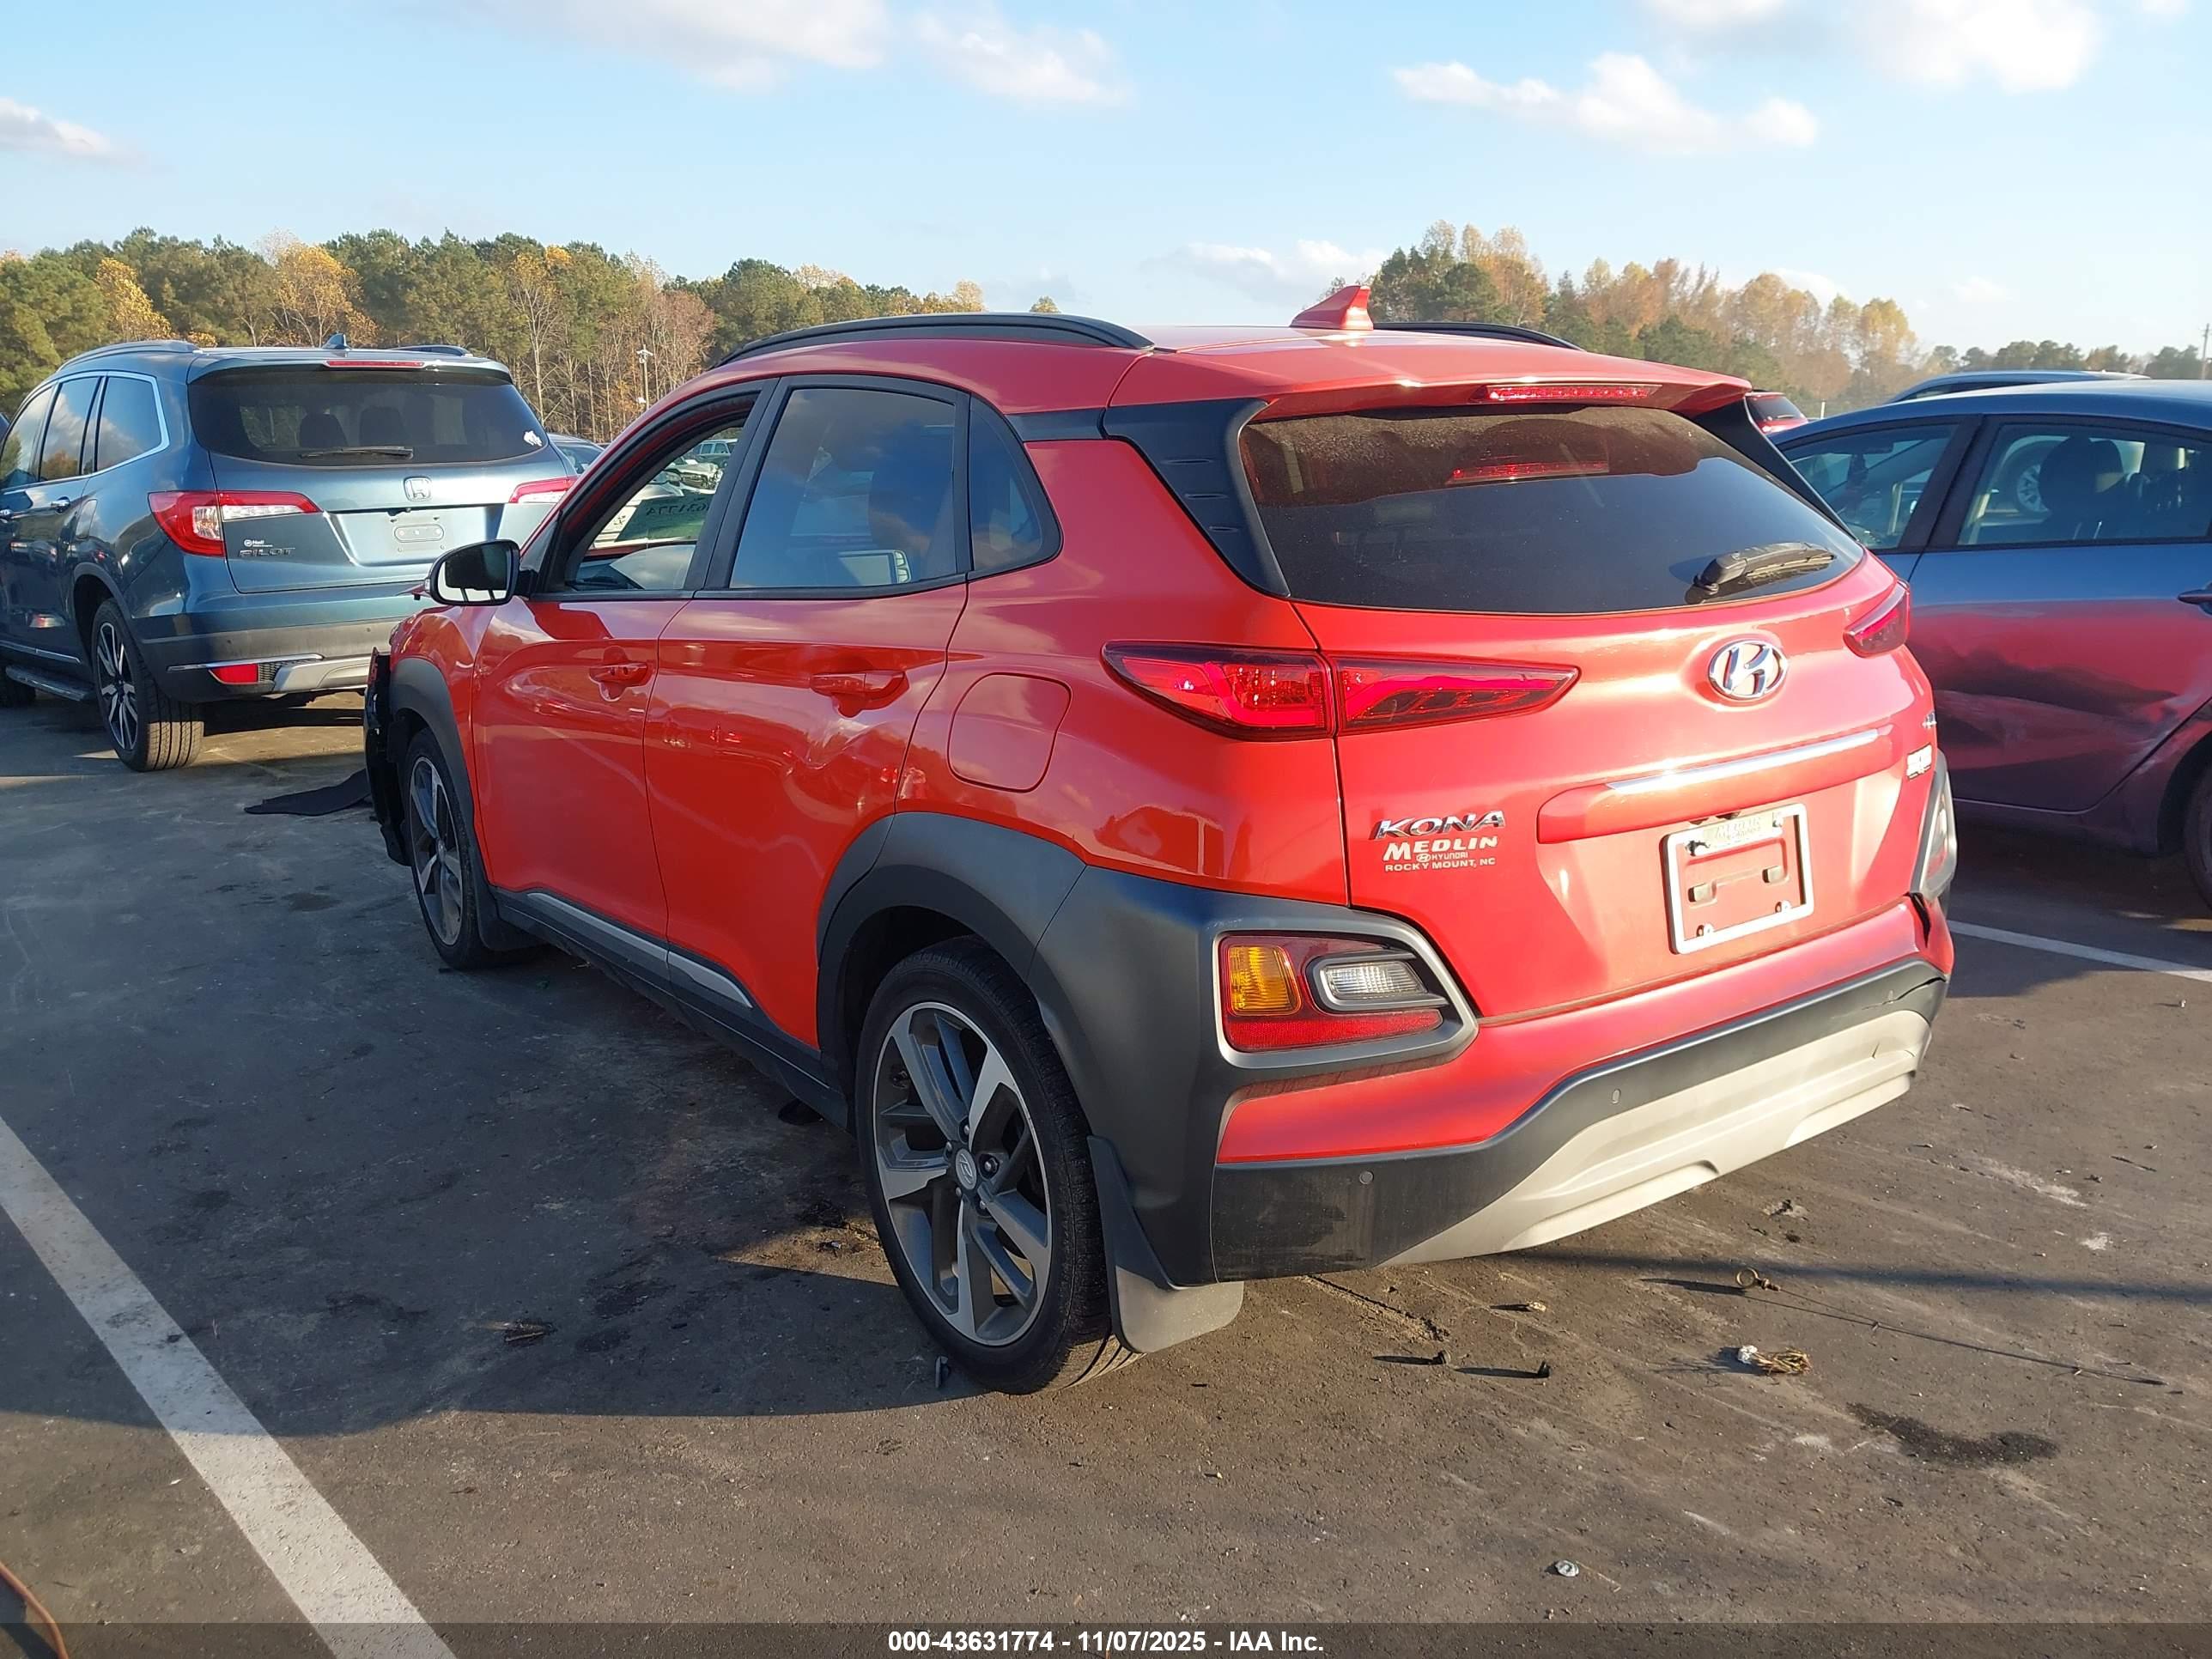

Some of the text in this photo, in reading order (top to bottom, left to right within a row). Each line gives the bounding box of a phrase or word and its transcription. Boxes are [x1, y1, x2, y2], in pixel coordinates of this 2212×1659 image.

[239, 547, 295, 557] PILOT
[1371, 811, 1505, 840] KONA
[1382, 836, 1498, 861] MEDLIN
[1385, 863, 1429, 872] ROCKY
[1431, 860, 1476, 868] MOUNT,
